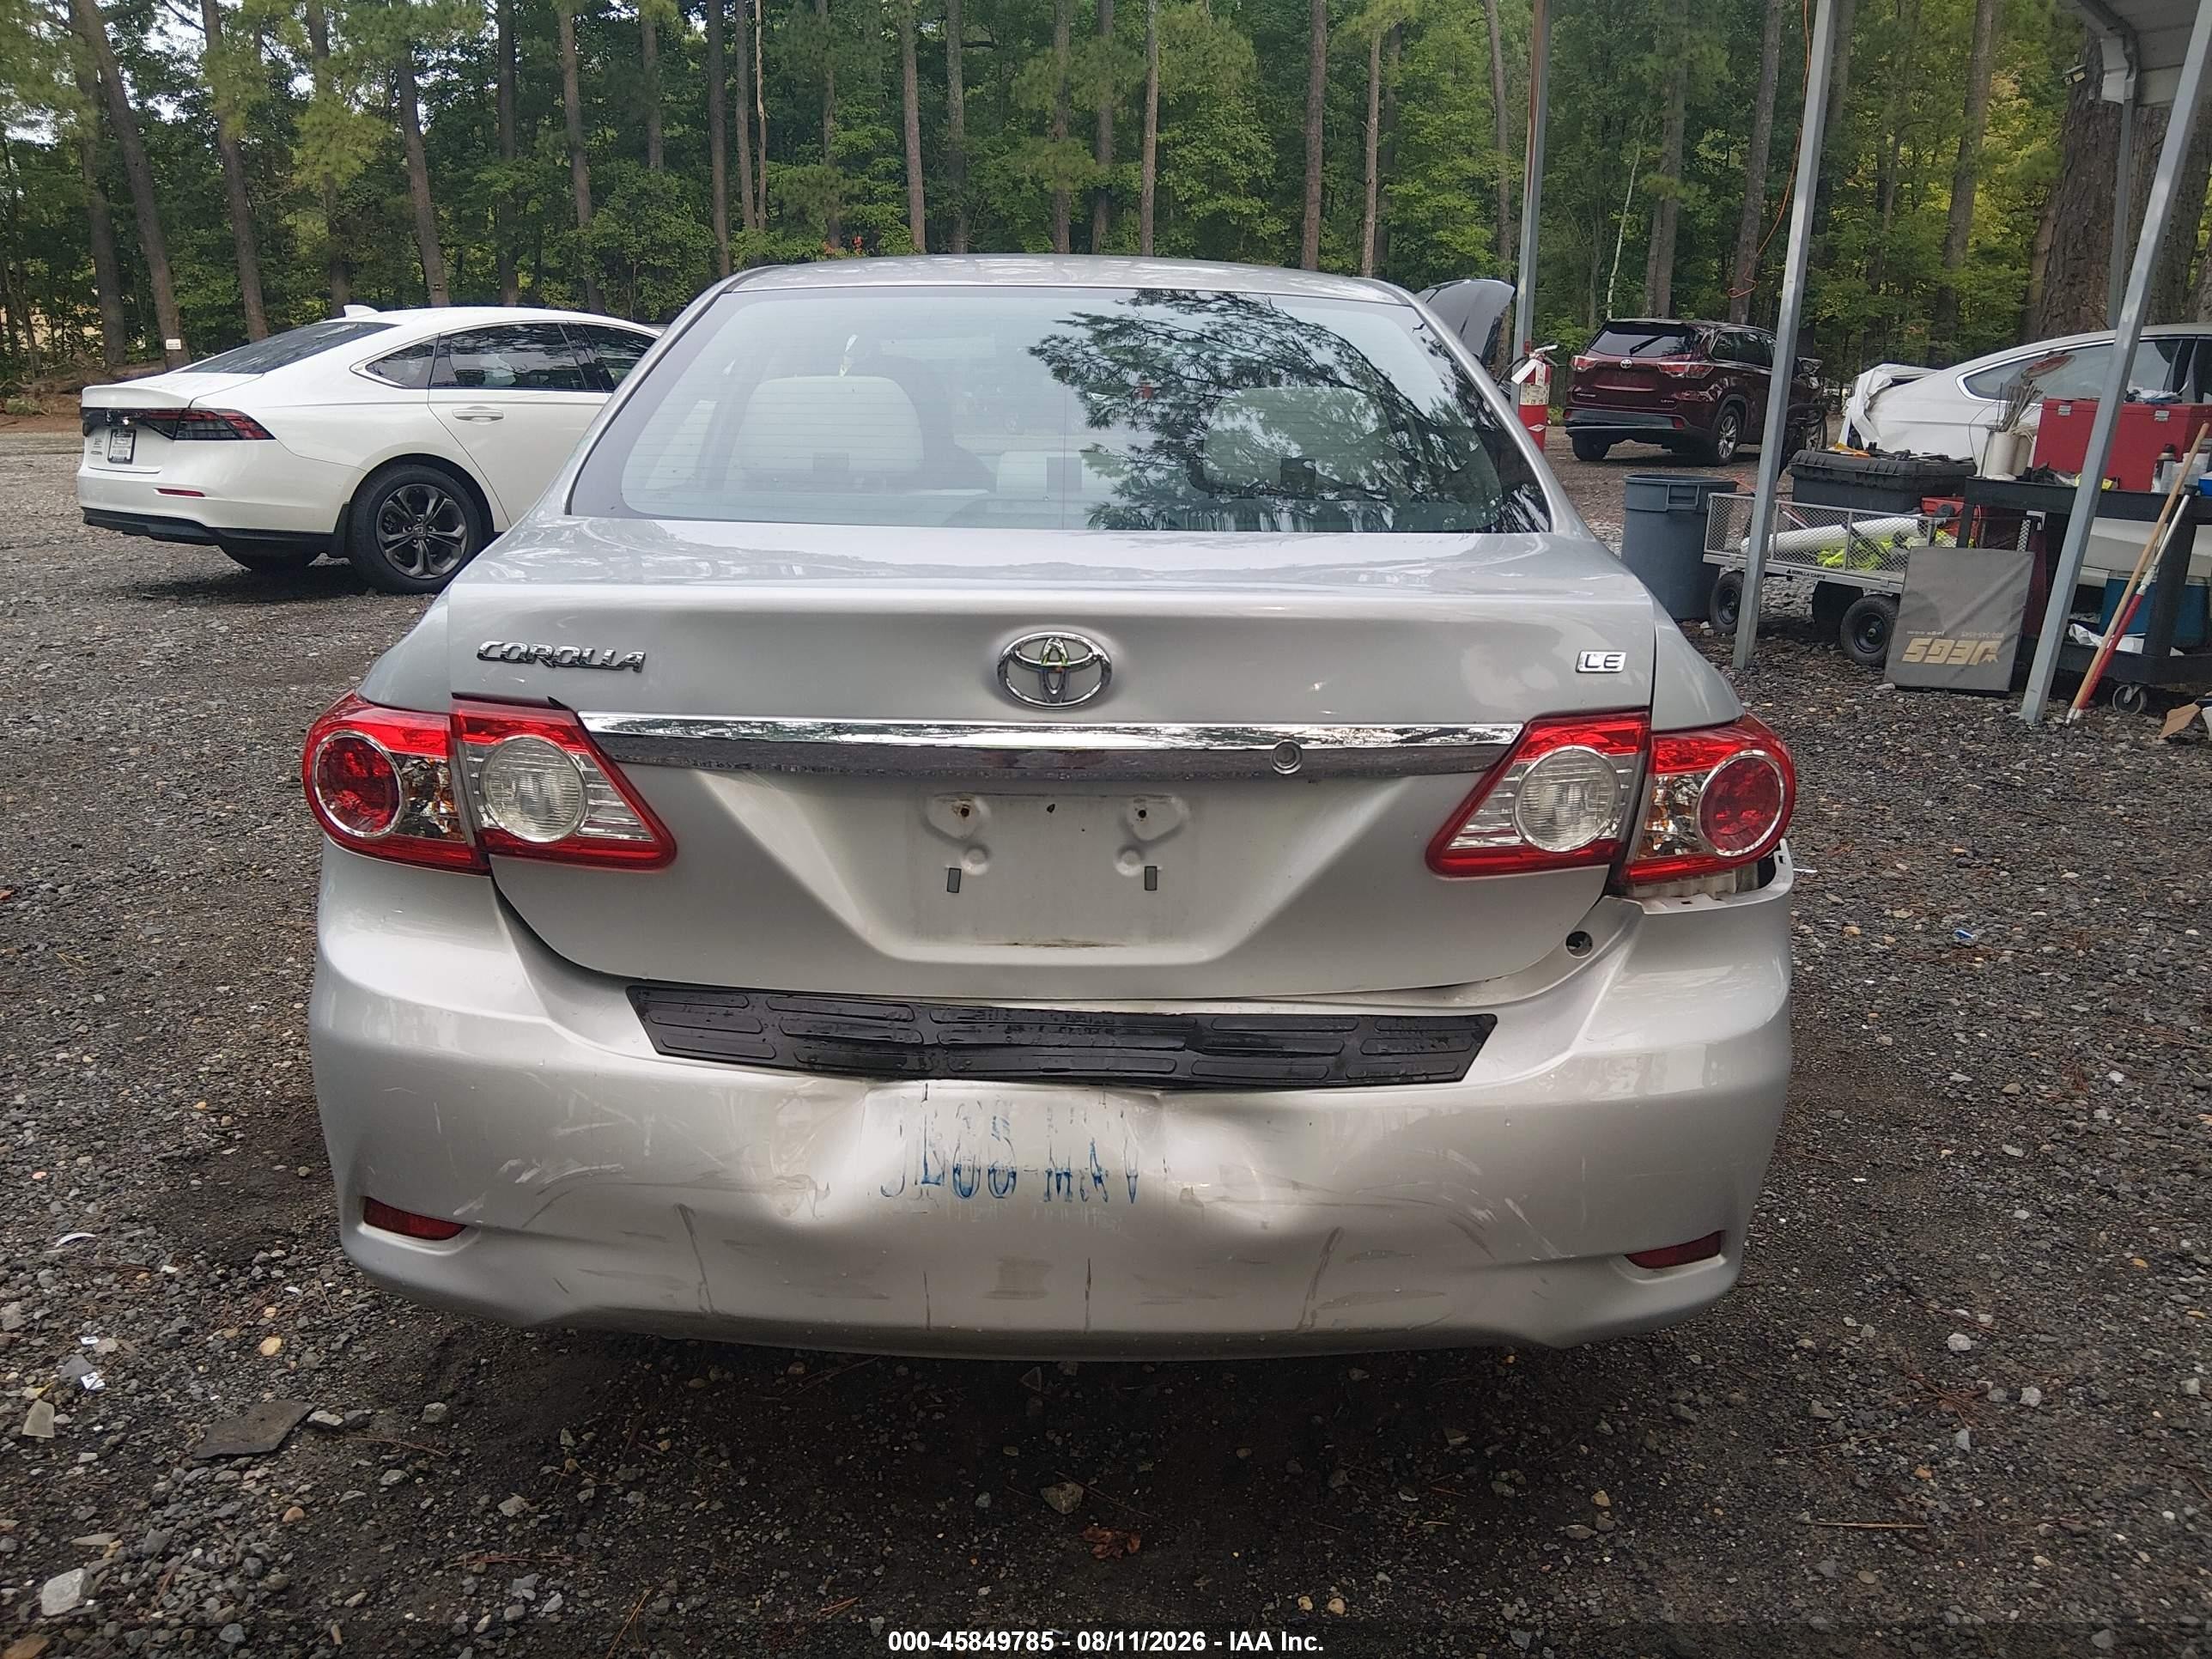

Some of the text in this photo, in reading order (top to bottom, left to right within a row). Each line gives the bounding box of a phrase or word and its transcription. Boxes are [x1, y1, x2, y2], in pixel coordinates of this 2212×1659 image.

[477, 641, 646, 673] COROLLA
[1583, 653, 1622, 668] LE
[1901, 638, 2001, 665] JEGS
